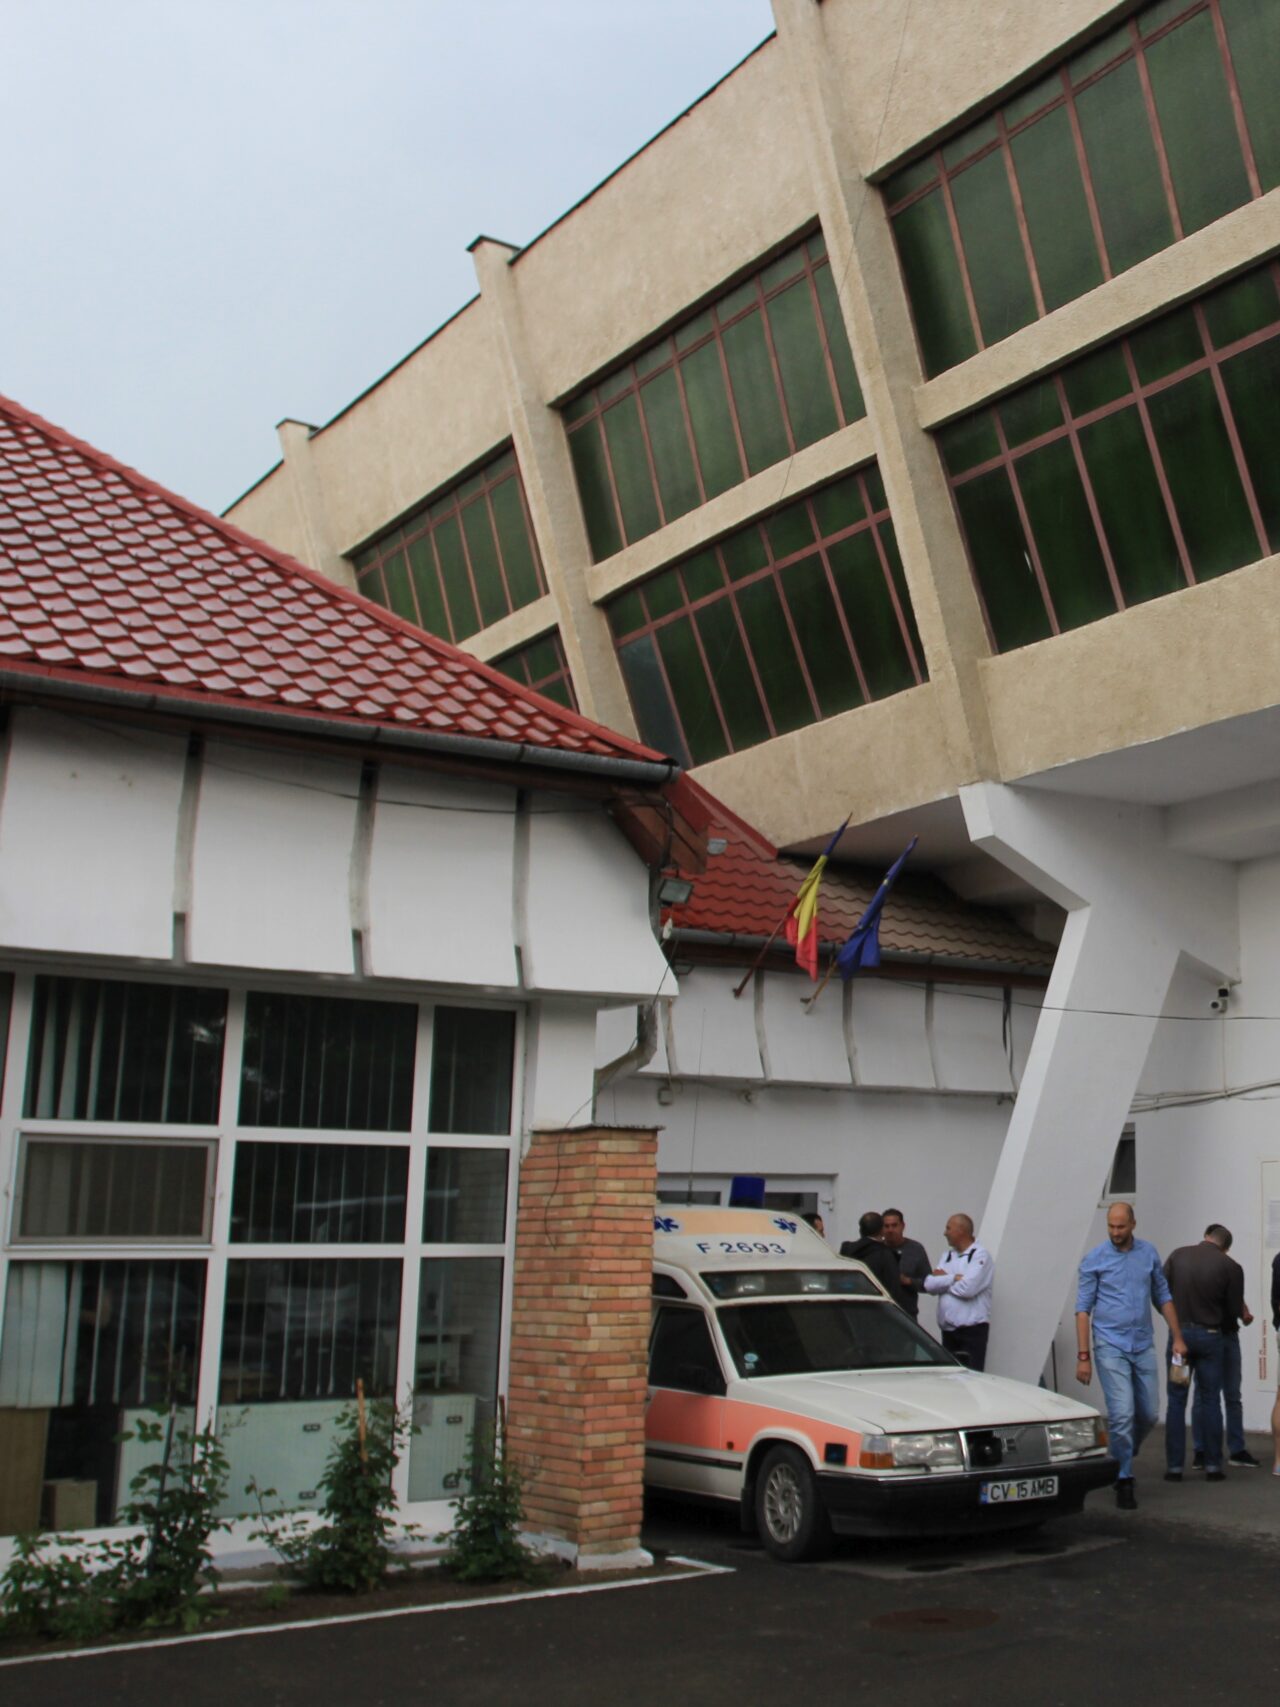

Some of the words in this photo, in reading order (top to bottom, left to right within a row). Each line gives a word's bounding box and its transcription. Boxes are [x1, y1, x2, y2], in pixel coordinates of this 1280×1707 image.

[696, 1242, 711, 1254] F
[719, 1242, 786, 1254] 2693
[990, 1484, 1011, 1501] CV
[1016, 1481, 1028, 1498] 15
[1031, 1478, 1055, 1497] AMB
